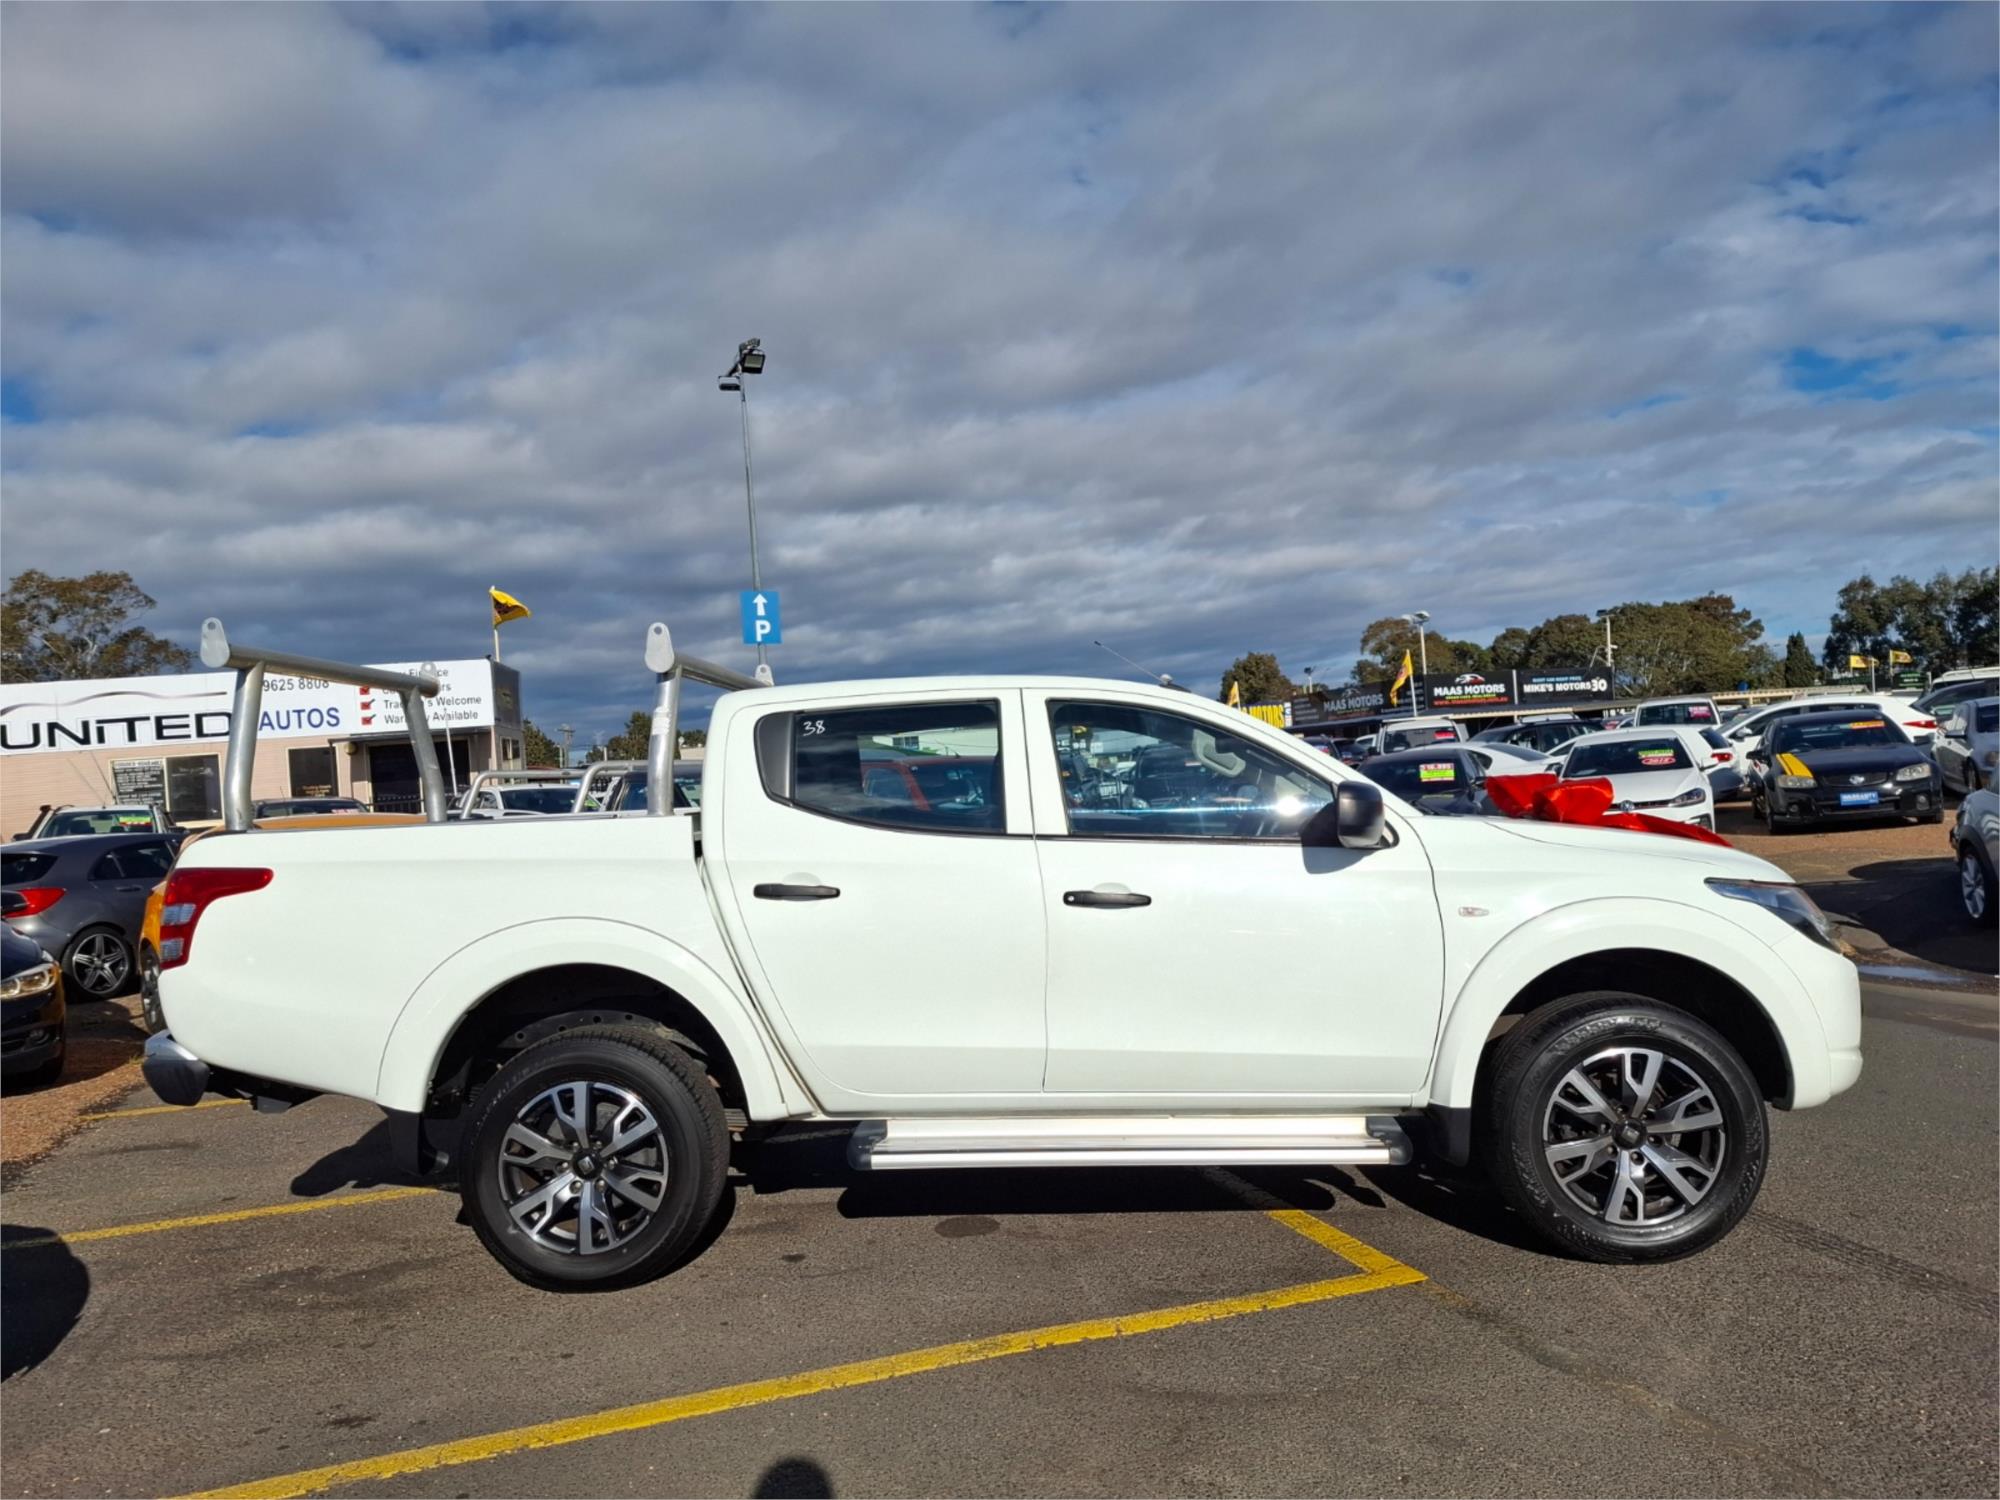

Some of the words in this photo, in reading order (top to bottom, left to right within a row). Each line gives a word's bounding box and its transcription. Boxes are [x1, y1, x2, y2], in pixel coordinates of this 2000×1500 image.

[755, 620, 771, 642] P
[263, 678, 295, 692] 9625
[1433, 686, 1462, 696] MAAS
[1464, 684, 1505, 695] MOTORS
[1523, 683, 1554, 693] MIKE'S
[1555, 681, 1591, 692] MOTORS
[436, 696, 482, 706] Welcome
[1324, 699, 1347, 712] MAAS
[1348, 694, 1384, 709] MOTORS
[433, 710, 478, 721] Available
[0, 712, 232, 750] UNITED
[259, 707, 340, 730] AUTOS
[803, 720, 825, 736] 38
